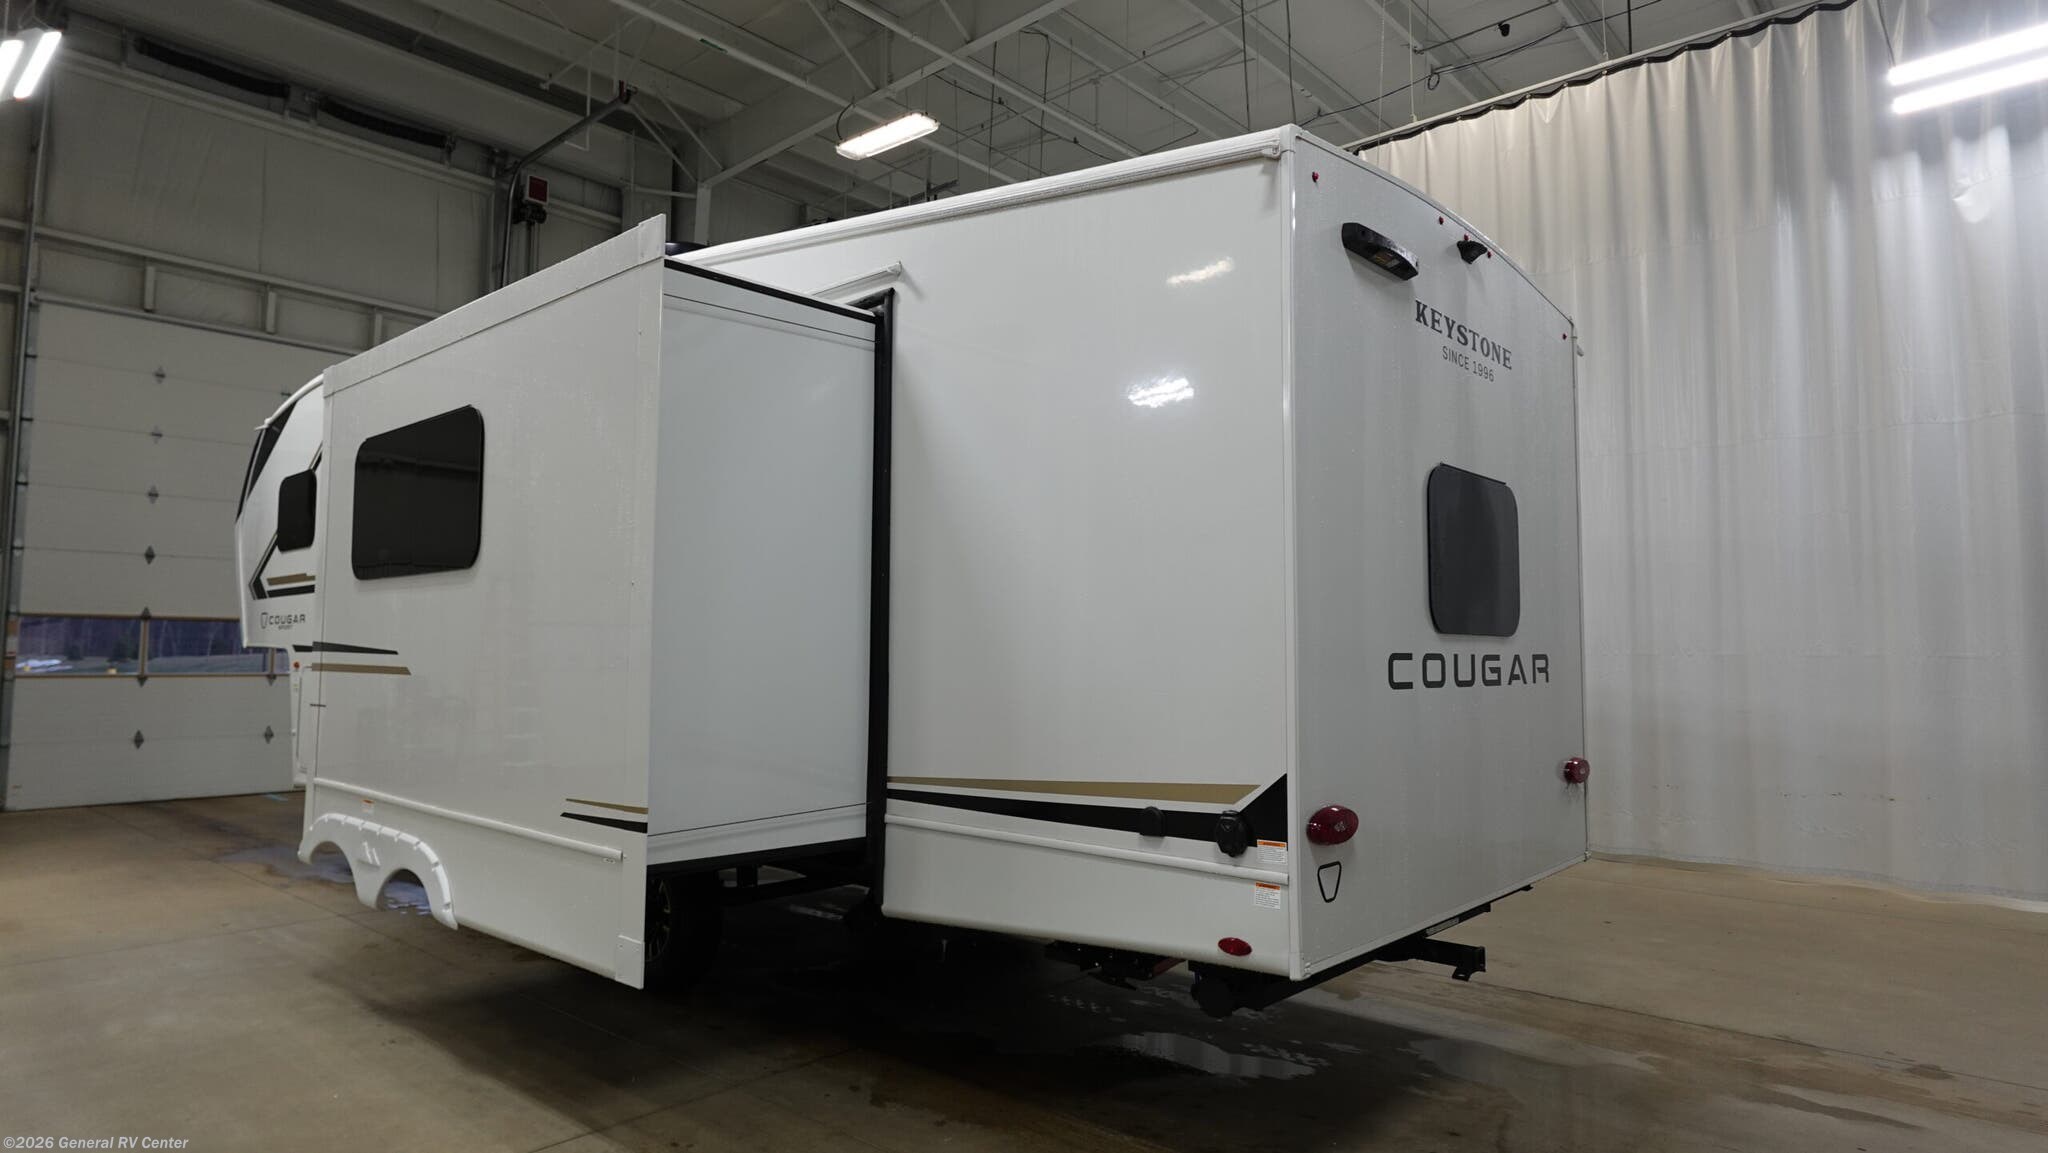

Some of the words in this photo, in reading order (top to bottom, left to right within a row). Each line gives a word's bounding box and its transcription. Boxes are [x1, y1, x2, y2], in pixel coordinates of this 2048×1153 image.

[1415, 299, 1512, 370] KEYSTONE
[1442, 345, 1470, 370] SINCE
[1473, 361, 1495, 382] 1996
[269, 614, 306, 625] COUGAR
[1388, 652, 1550, 690] COUGAR
